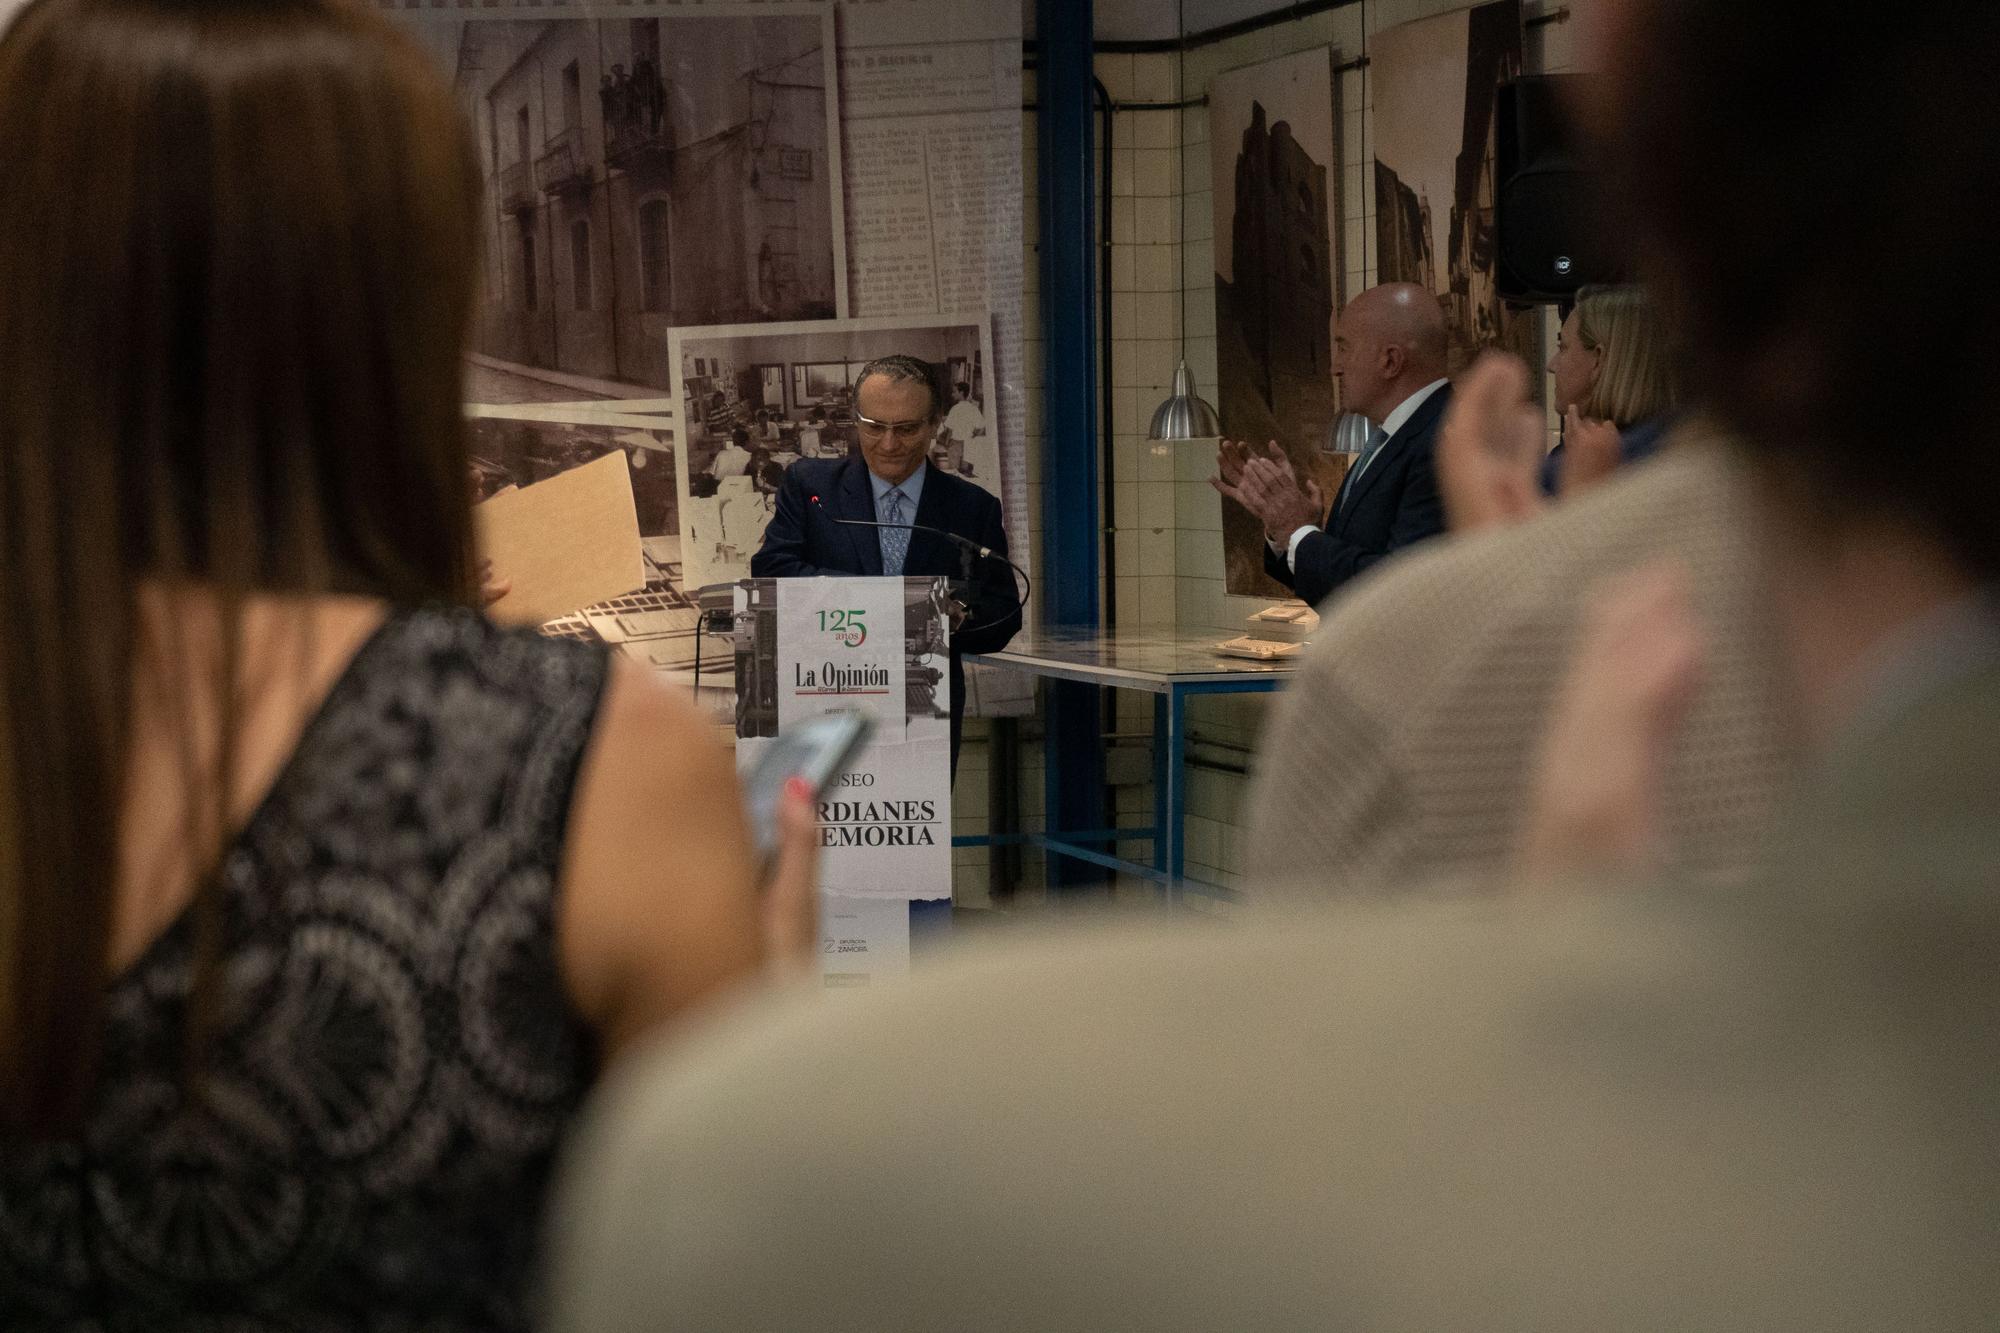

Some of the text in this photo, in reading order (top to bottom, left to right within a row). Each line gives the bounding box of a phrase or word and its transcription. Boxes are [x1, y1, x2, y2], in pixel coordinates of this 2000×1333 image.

[815, 610, 867, 647] 125
[795, 661, 889, 694] La Opinión
[831, 773, 875, 787] USEO
[815, 800, 935, 822] RDIANES
